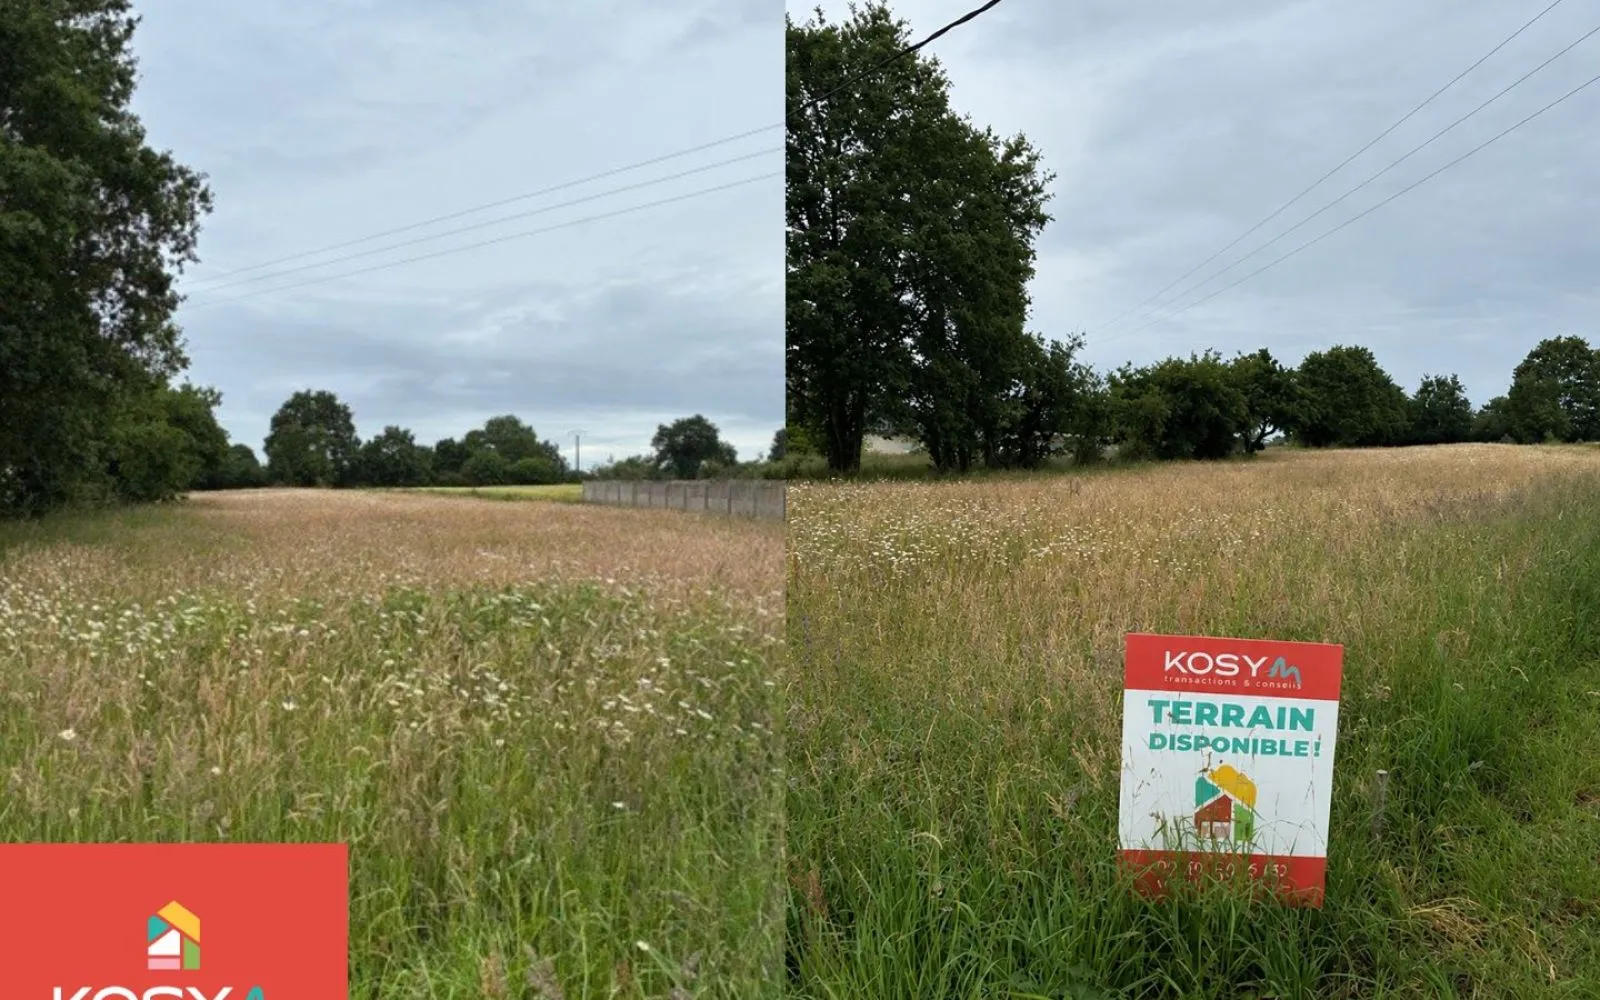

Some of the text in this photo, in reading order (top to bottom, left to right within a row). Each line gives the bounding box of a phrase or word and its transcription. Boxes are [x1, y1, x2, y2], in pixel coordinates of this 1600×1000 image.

[1164, 675, 1237, 686] transactions
[1243, 679, 1251, 688] &
[1148, 700, 1315, 732] TERRAIN
